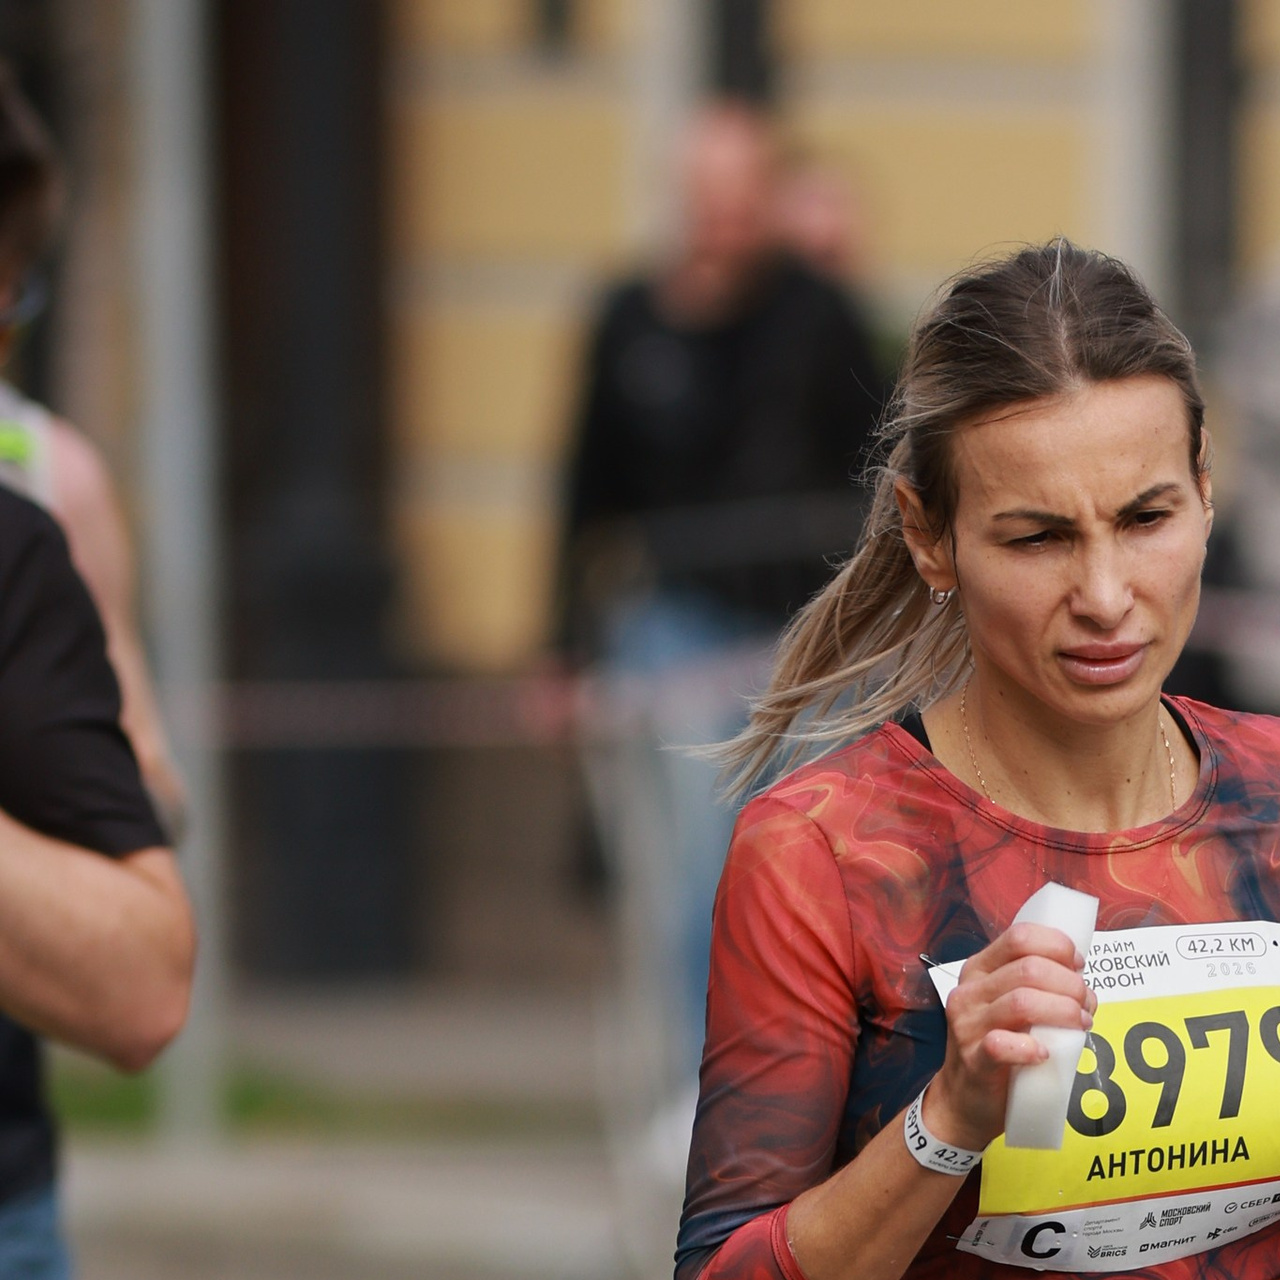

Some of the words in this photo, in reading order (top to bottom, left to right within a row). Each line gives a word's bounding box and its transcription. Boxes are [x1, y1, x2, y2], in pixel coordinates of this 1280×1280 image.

[1088, 940, 1135, 957] РАЙМ
[1188, 938, 1224, 954] 42,2
[1229, 937, 1255, 951] КМ
[1083, 950, 1171, 975] КОВСКИЙ
[1206, 961, 1256, 978] 2026
[934, 1148, 974, 1166] 42,2
[1086, 1136, 1250, 1182] АНТОНИНА
[1161, 1202, 1212, 1218] МОСКОВСКИЙ
[1240, 1197, 1271, 1210] СБЕР
[1159, 1216, 1184, 1228] СПОРТ
[1100, 1249, 1127, 1258] BRICS
